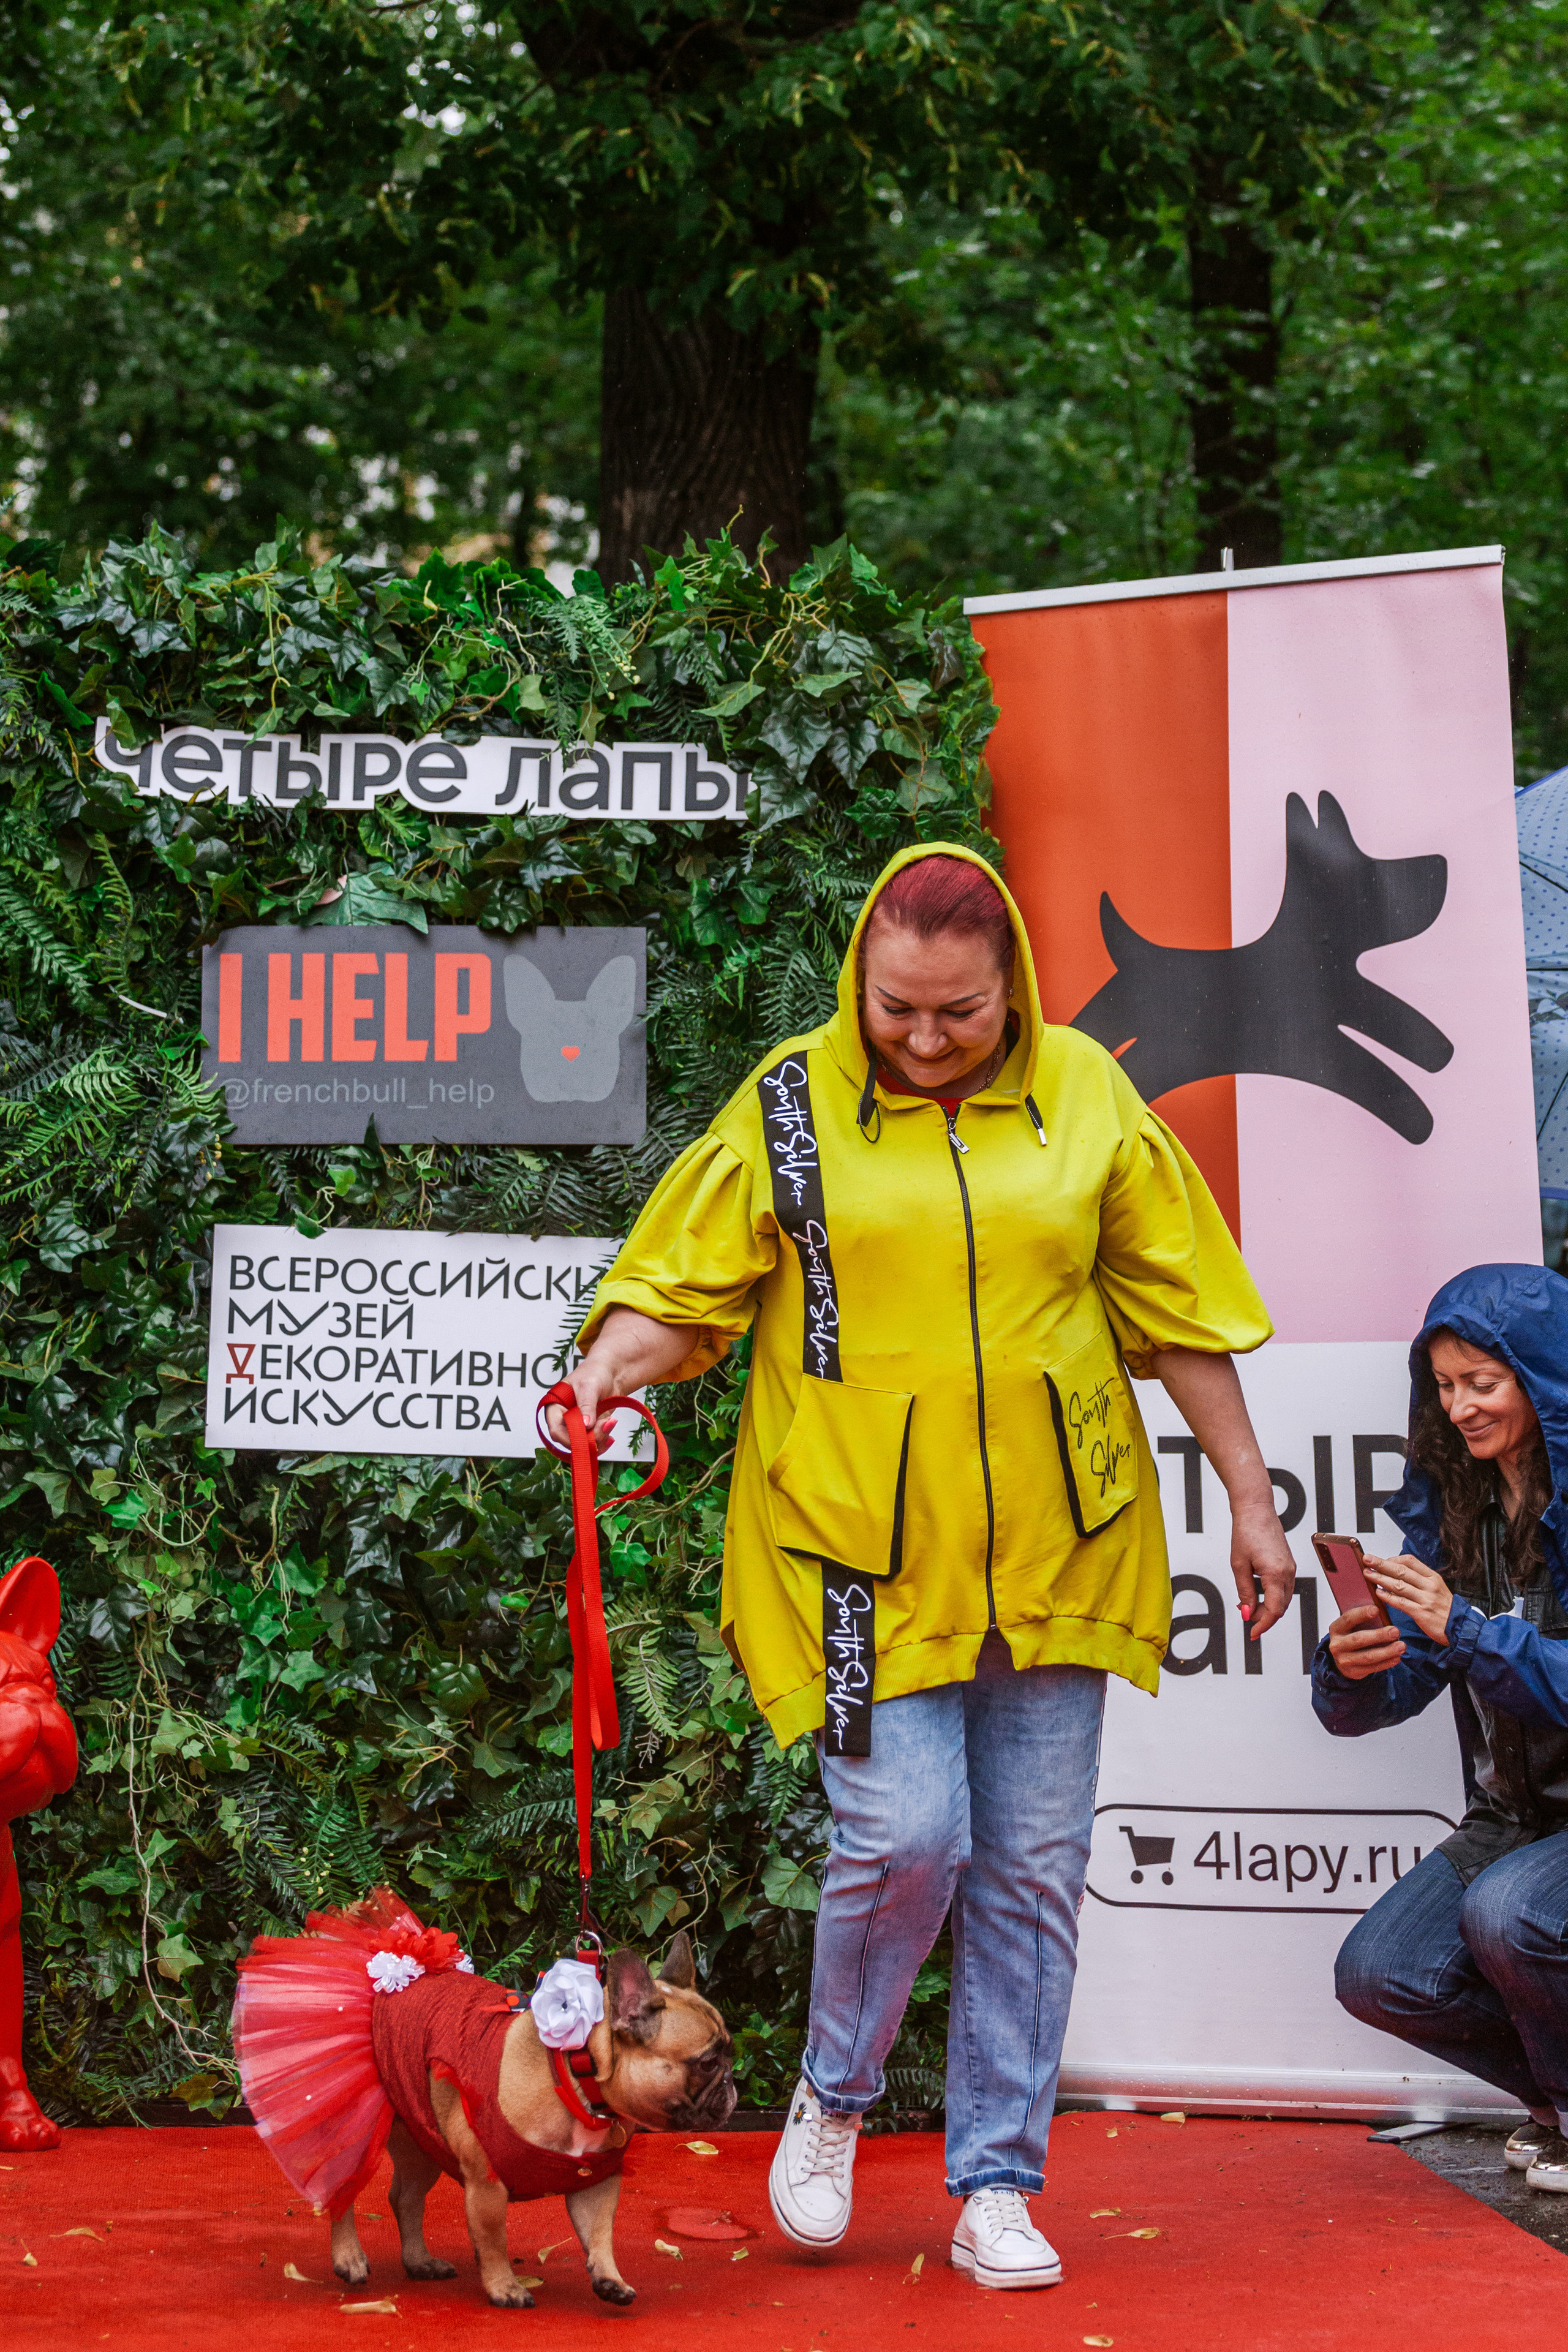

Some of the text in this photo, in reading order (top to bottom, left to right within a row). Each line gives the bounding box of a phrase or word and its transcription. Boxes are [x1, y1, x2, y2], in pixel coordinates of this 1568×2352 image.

[219, 952, 491, 1062] I HELP
[220, 1078, 495, 1110] @frenchbull_help
[229, 1255, 606, 1302] ВСЕРОССИЙСКИ
[228, 1297, 414, 1340] МУЗЕЙ
[225, 1343, 586, 1389] ДЕКОРАТИВНО
[224, 1387, 511, 1432] ИСКУССТВА
[1194, 1831, 1420, 1893] 4lapy.ru
